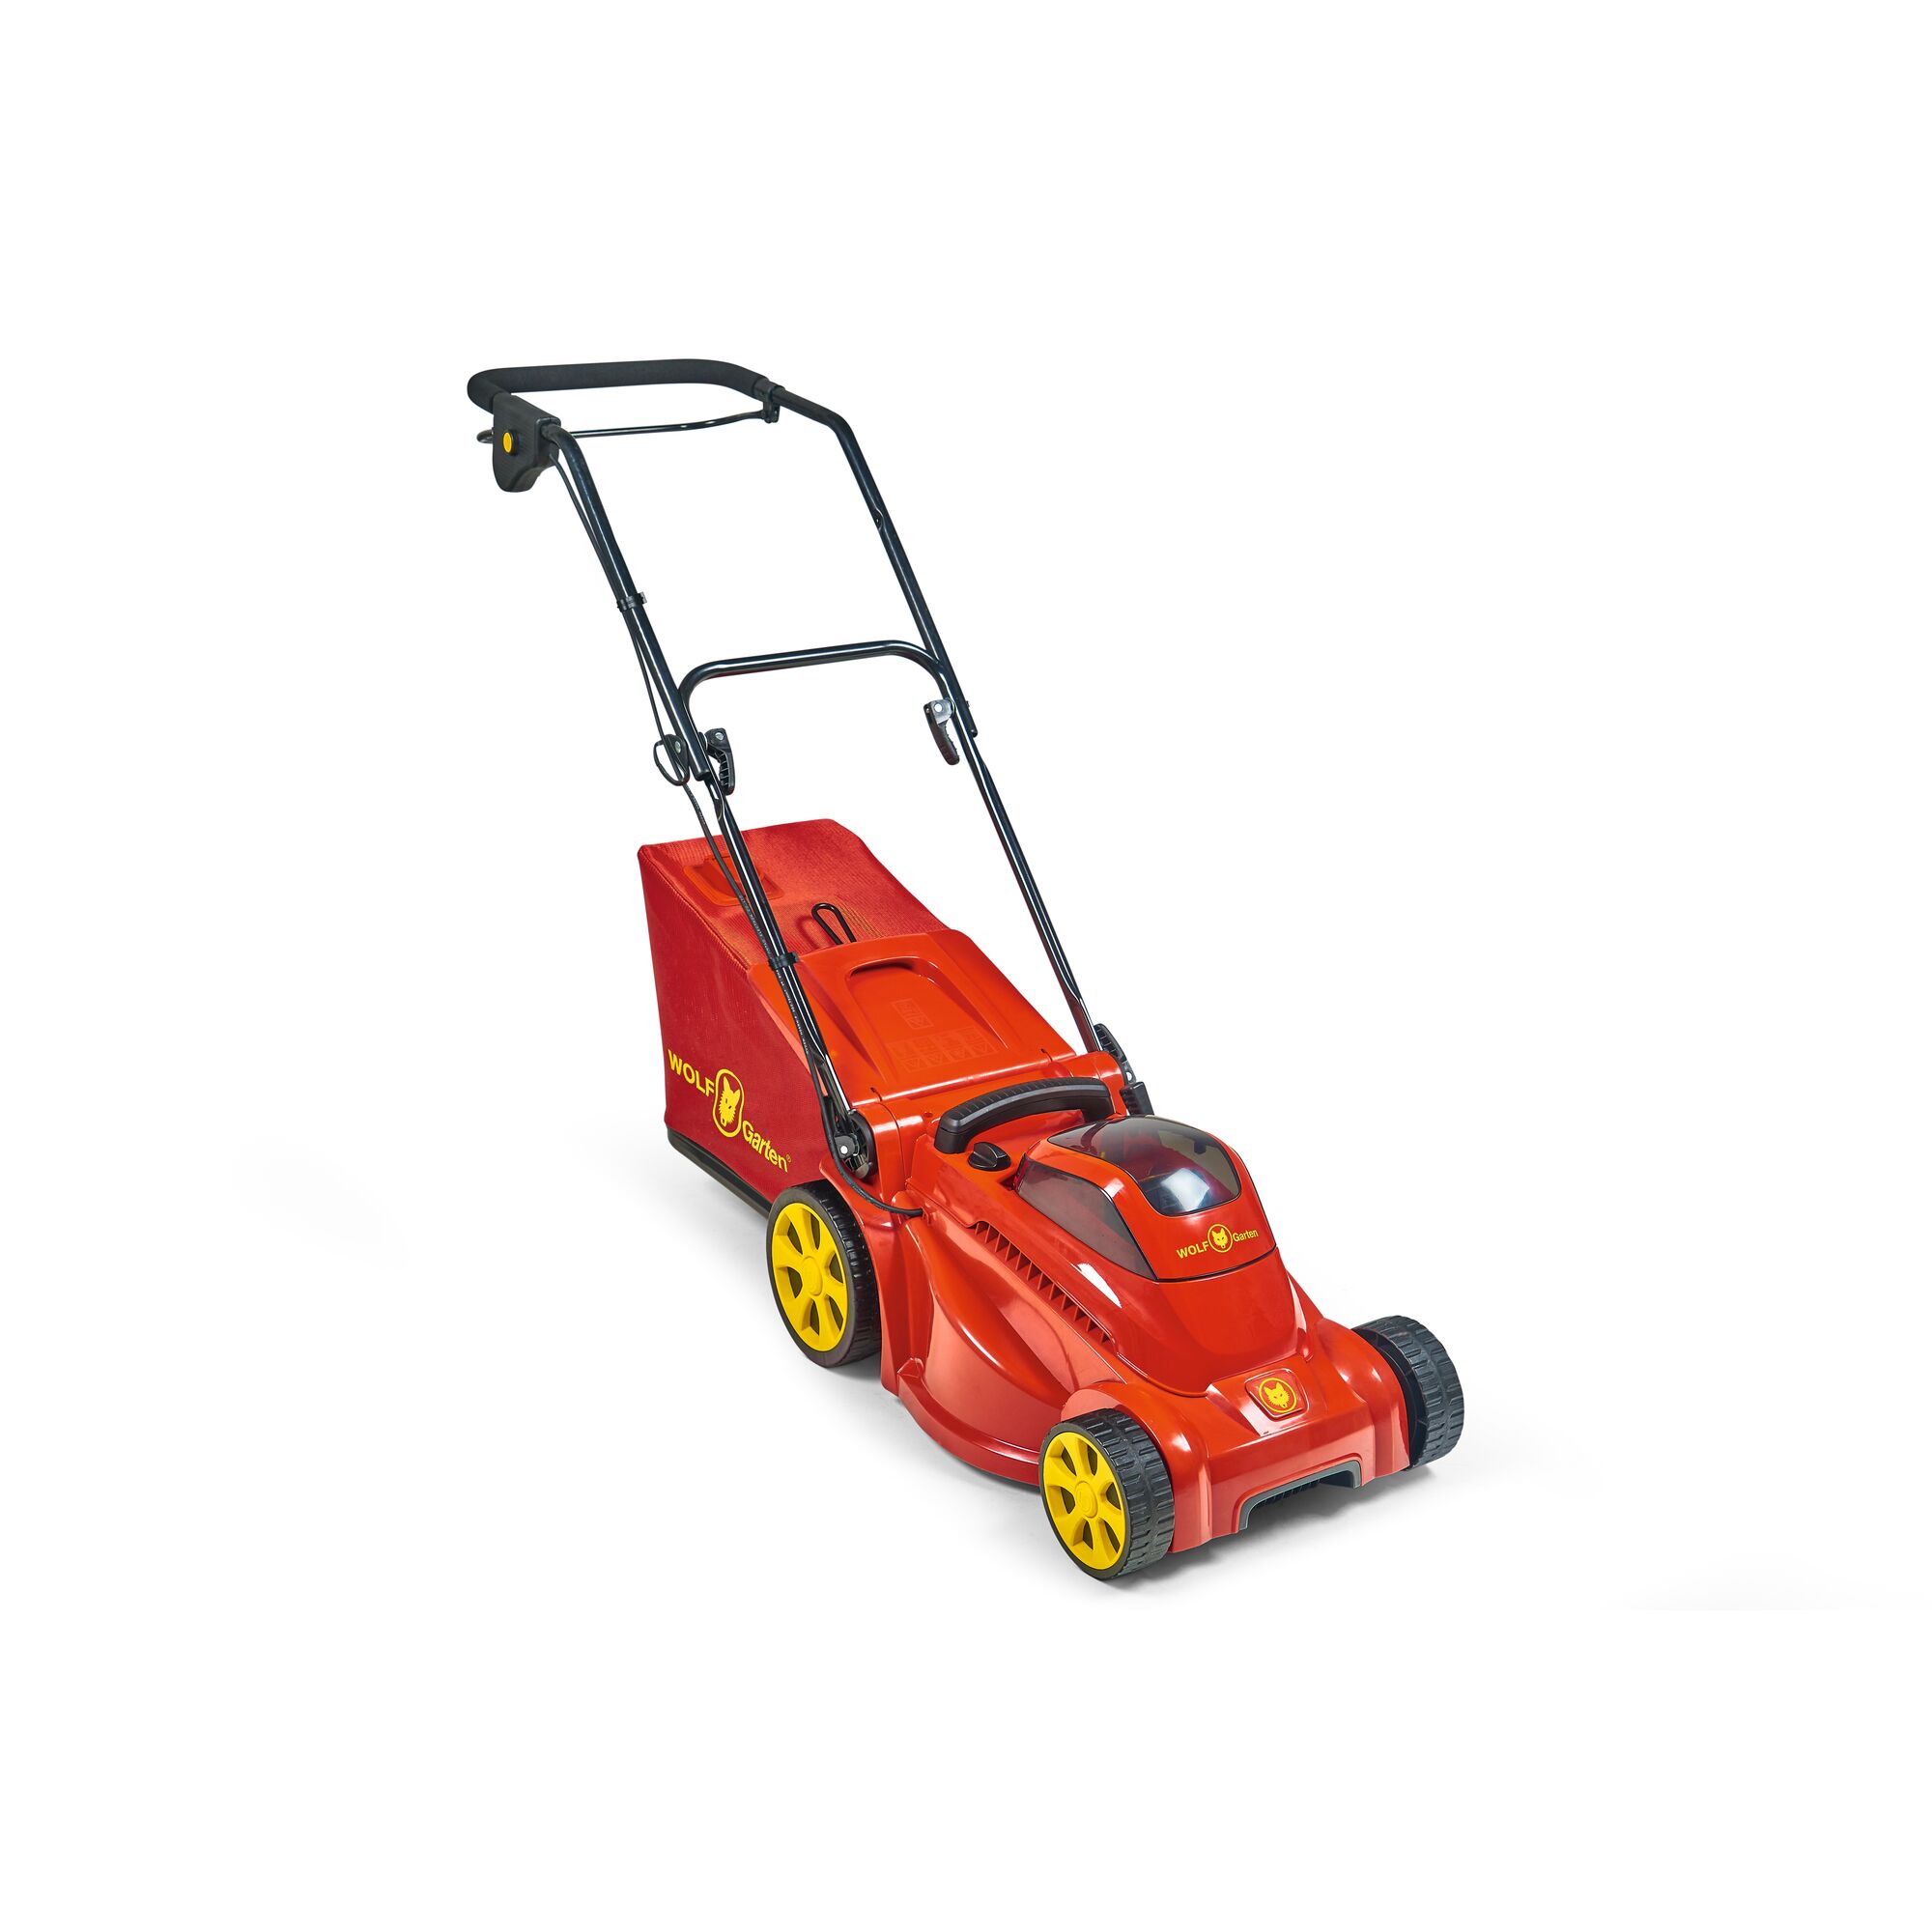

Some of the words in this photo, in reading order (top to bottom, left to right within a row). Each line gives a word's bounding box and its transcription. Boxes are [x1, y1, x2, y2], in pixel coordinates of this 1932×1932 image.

[668, 1049, 715, 1096] WOLF
[1176, 1240, 1209, 1259] WOLF
[1232, 1230, 1259, 1242] Garten
